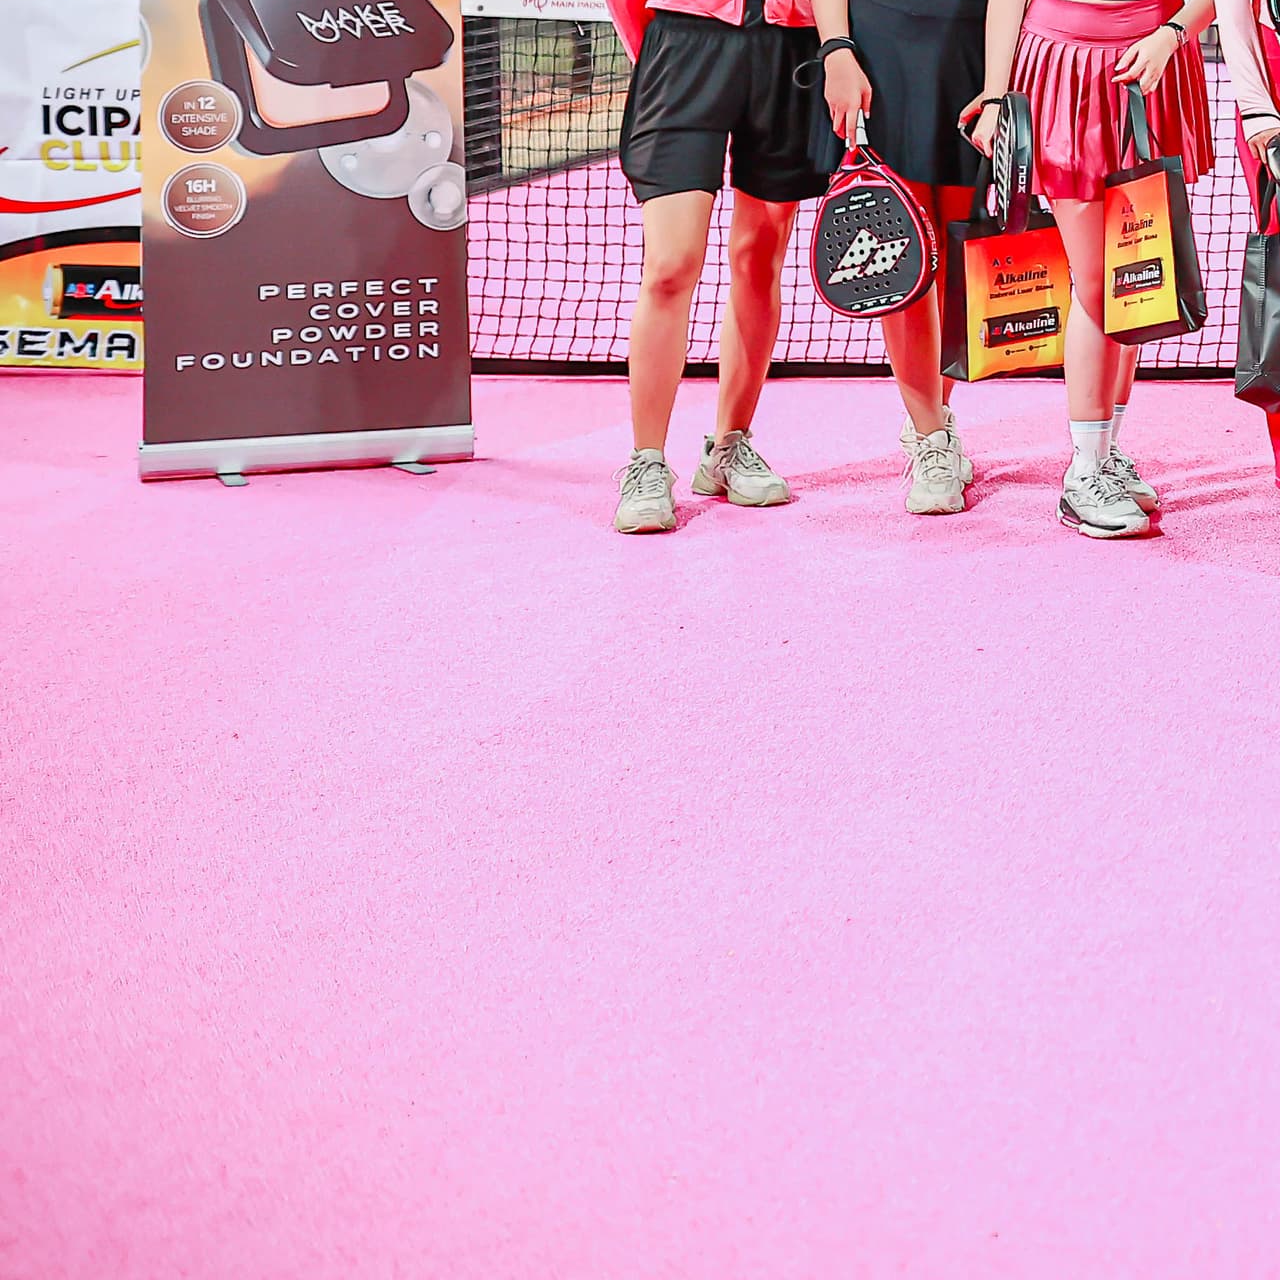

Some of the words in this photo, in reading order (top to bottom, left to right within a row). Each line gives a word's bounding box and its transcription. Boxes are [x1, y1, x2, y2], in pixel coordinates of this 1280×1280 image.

[43, 87, 105, 99] LIGHT
[117, 89, 141, 101] UP
[184, 101, 195, 110] IN
[197, 97, 216, 110] 12
[171, 112, 228, 124] EXTENSIVE
[182, 126, 217, 136] SHADE
[40, 140, 142, 172] CLU
[185, 178, 217, 194] 16H
[994, 270, 1048, 288] Alkaline
[1122, 268, 1160, 284] Alkaline
[259, 278, 439, 301] PERFECT
[309, 300, 439, 320] COVER
[272, 321, 439, 344] POWDER
[1002, 316, 1056, 335] Alkaline
[176, 343, 440, 372] FOUNDATION
